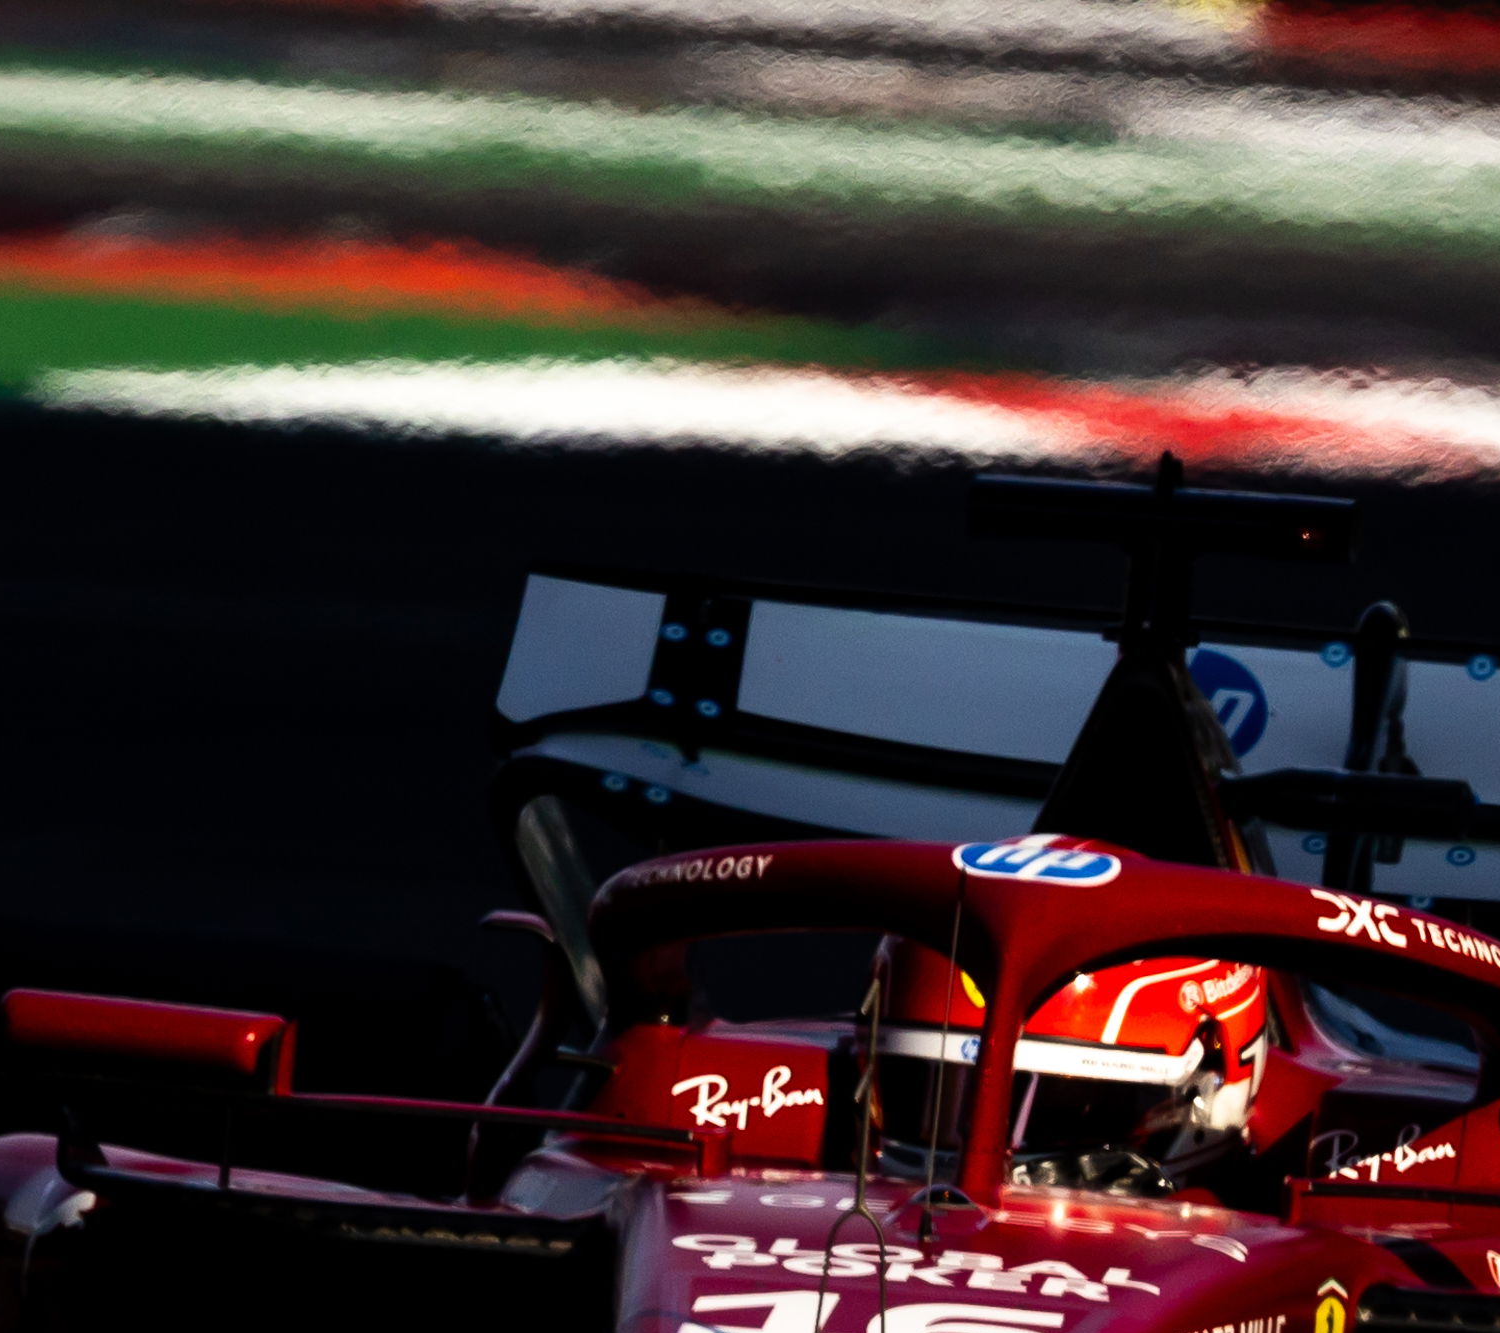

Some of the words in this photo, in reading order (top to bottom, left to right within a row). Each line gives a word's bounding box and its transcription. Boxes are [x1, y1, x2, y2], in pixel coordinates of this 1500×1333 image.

[965, 836, 1110, 883] hp
[1310, 888, 1407, 948] DXC
[670, 1064, 825, 1131] Ray-Ban
[1309, 1123, 1457, 1183] Ray-Ban
[671, 1233, 1161, 1297] GLOBAL
[702, 1249, 1110, 1303] POKER
